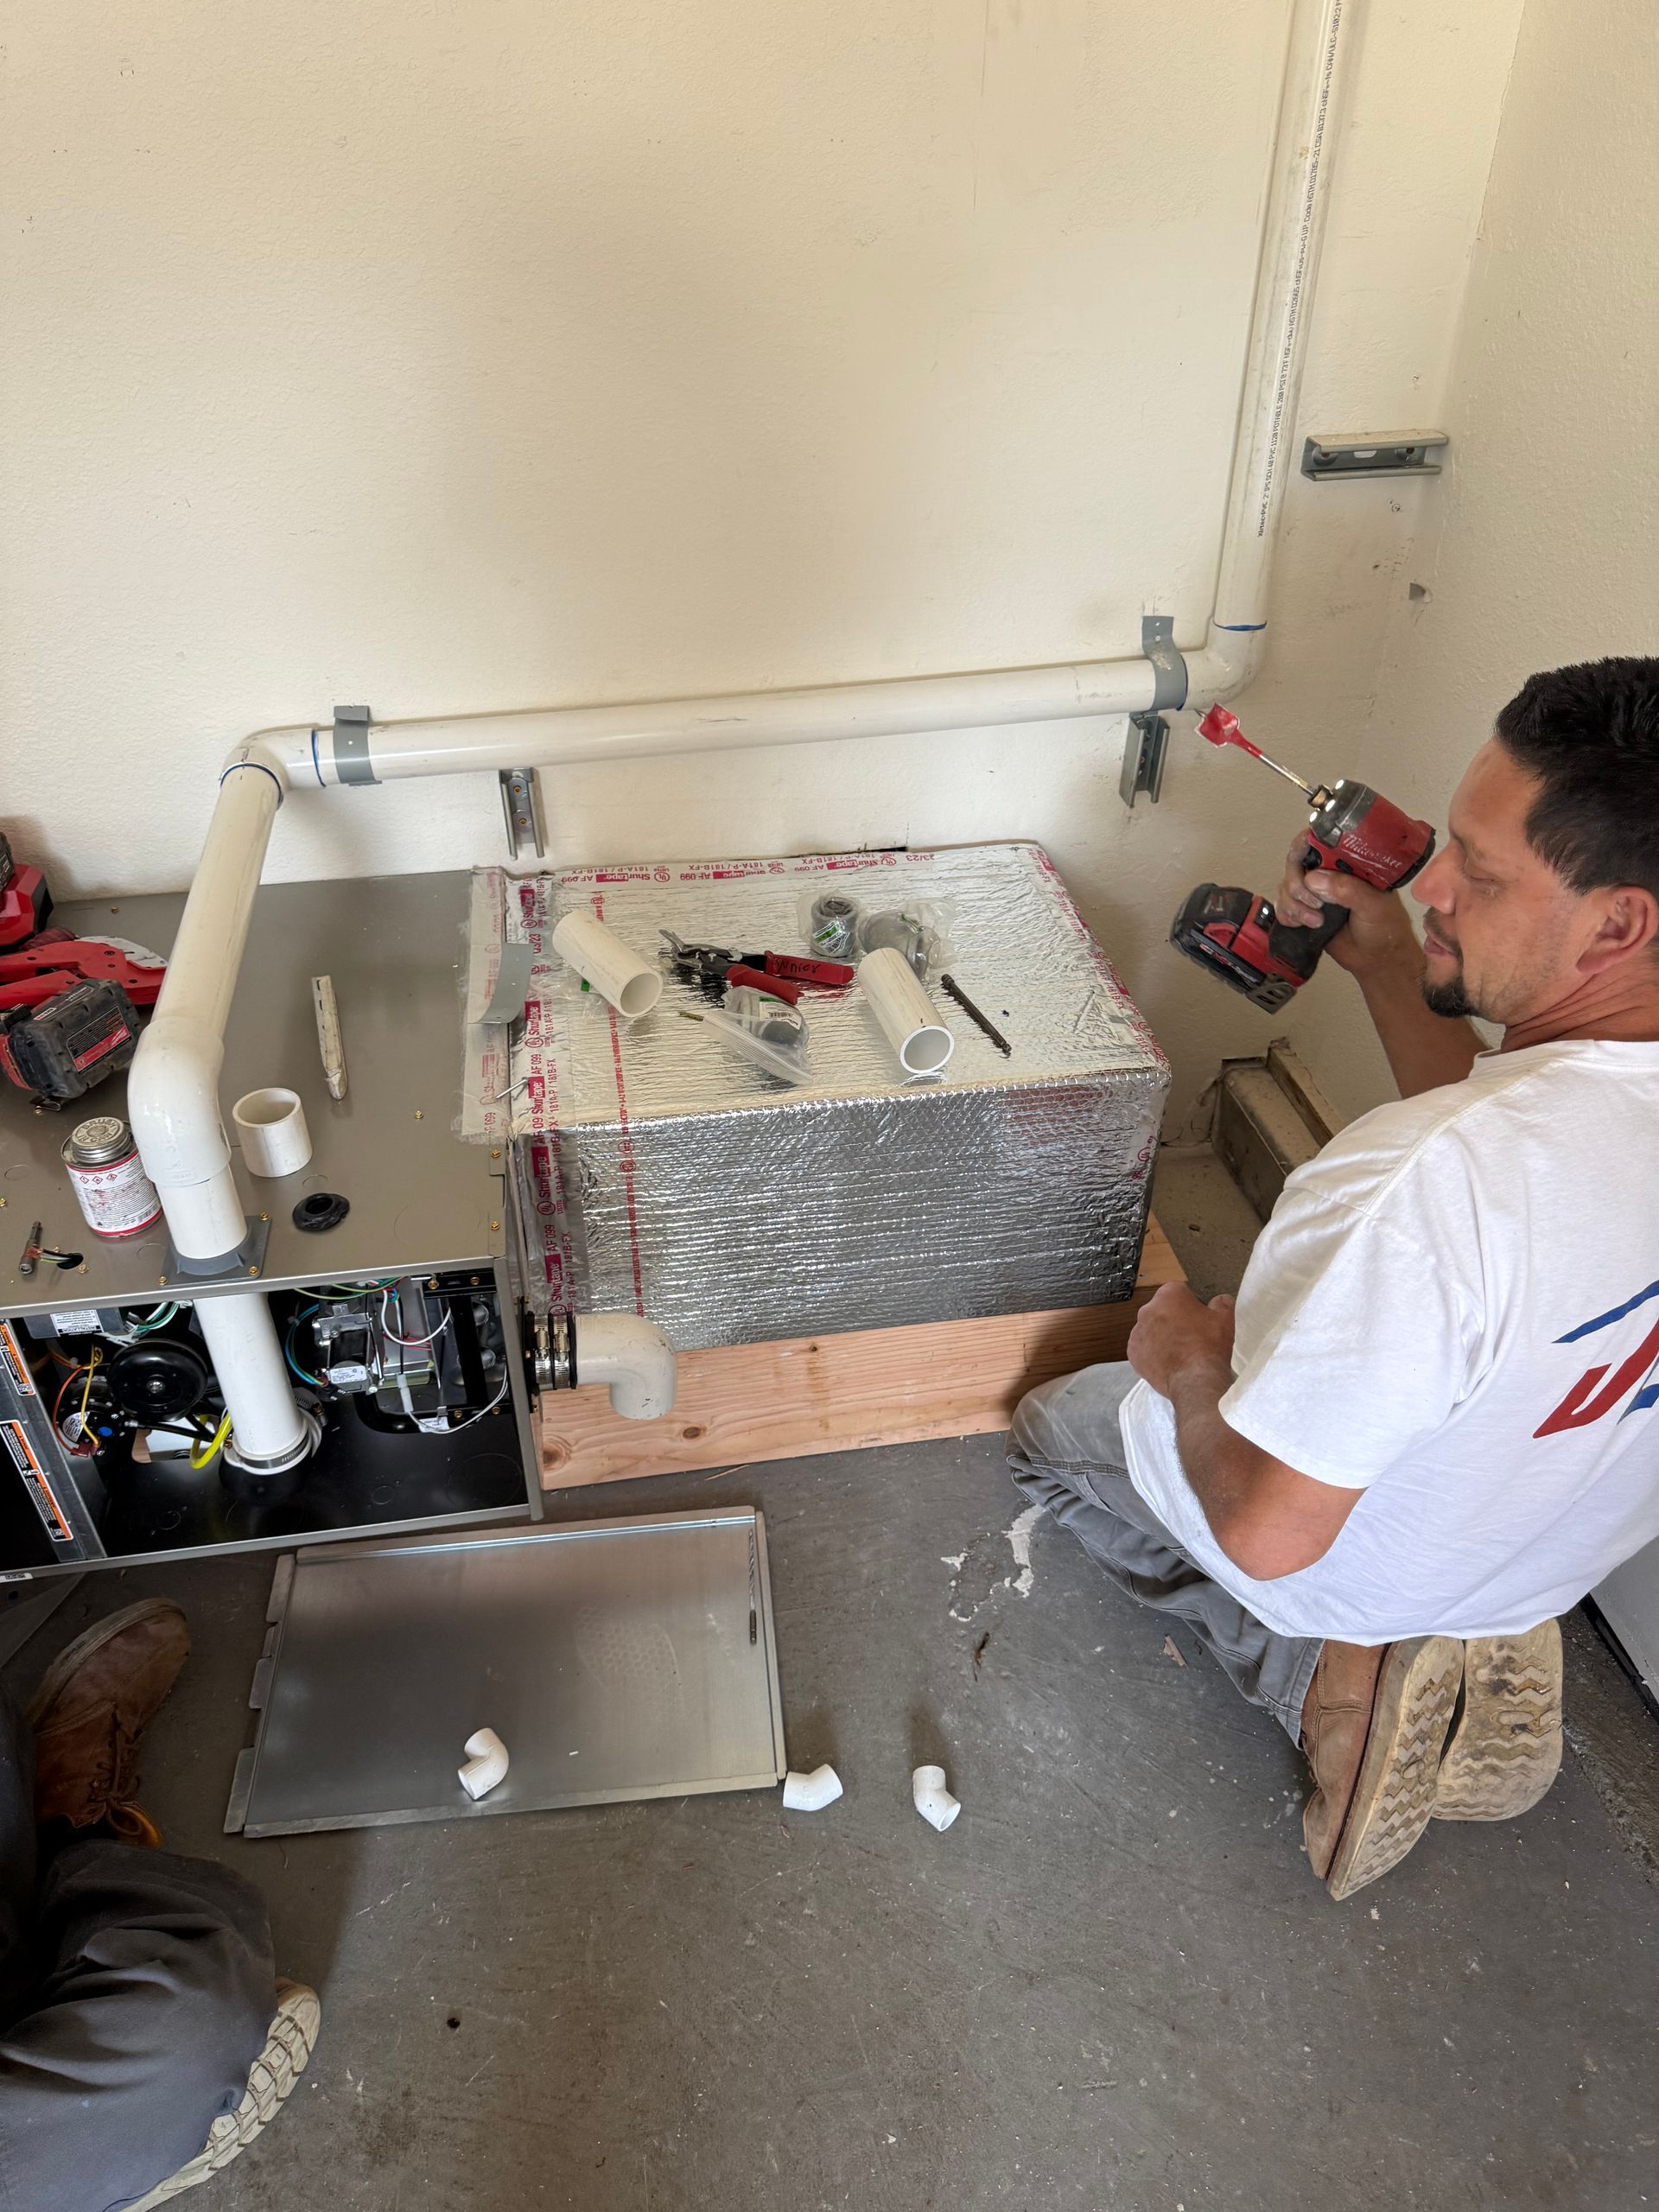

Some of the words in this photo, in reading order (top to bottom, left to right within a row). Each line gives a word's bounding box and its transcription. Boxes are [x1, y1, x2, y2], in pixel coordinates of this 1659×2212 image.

[1314, 130, 1323, 148] CSA
[603, 873, 651, 882] Shurtape
[528, 1005, 541, 1036] Shurtape
[543, 1014, 554, 1035] 181A-P
[531, 1054, 542, 1065] 099
[531, 1066, 543, 1075] AF
[546, 1058, 557, 1084] 181B-FX
[531, 1082, 545, 1114] Shurtape
[549, 1090, 559, 1113] 181A-P
[533, 1133, 544, 1144] AF
[537, 1157, 551, 1198] Shurtape
[554, 1166, 565, 1194] 181A-P
[544, 1224, 556, 1238] 099
[546, 1241, 557, 1252] AF
[561, 1231, 573, 1264] 181B-FX
[550, 1262, 563, 1301] Shurtape
[566, 1272, 576, 1299] 181A-P
